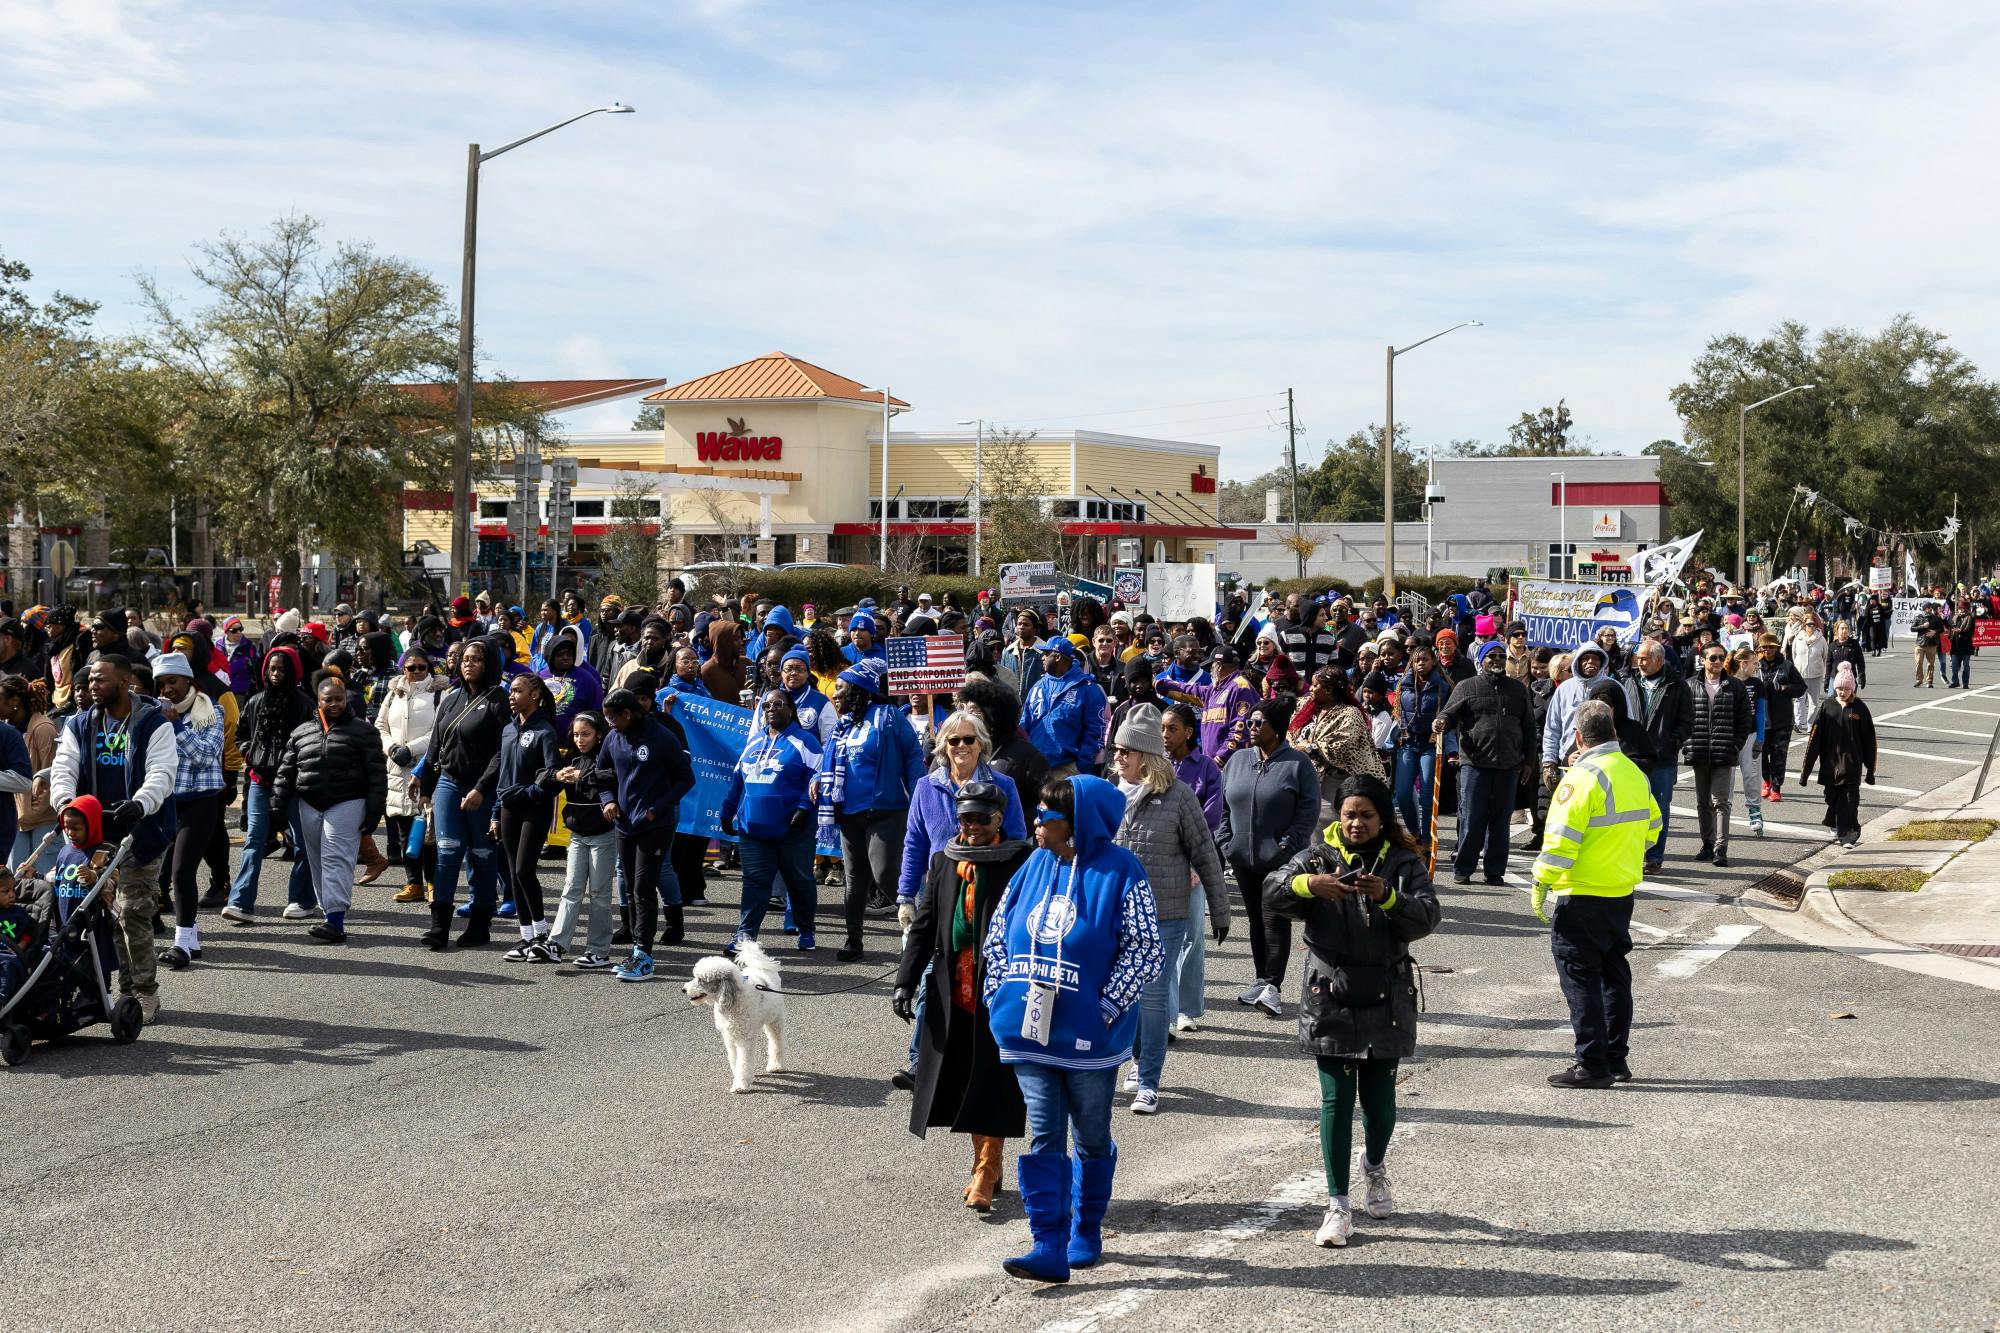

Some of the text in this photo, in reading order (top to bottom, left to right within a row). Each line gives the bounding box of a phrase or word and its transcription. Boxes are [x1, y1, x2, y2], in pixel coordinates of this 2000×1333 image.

[696, 432, 783, 462] Wawa
[1520, 583, 1596, 603] Gainesville
[1522, 600, 1570, 617] Women
[1571, 604, 1593, 618] For
[891, 670, 910, 681] END
[912, 668, 963, 679] CORPORATE
[896, 680, 959, 691] PERSONHOOD!
[683, 701, 752, 728] ZETA PHI BE
[96, 751, 126, 766] obil
[692, 756, 735, 770] SCHOLARSH
[700, 771, 732, 782] SERVICE
[1032, 961, 1048, 978] PHI
[1049, 964, 1079, 985] BETA
